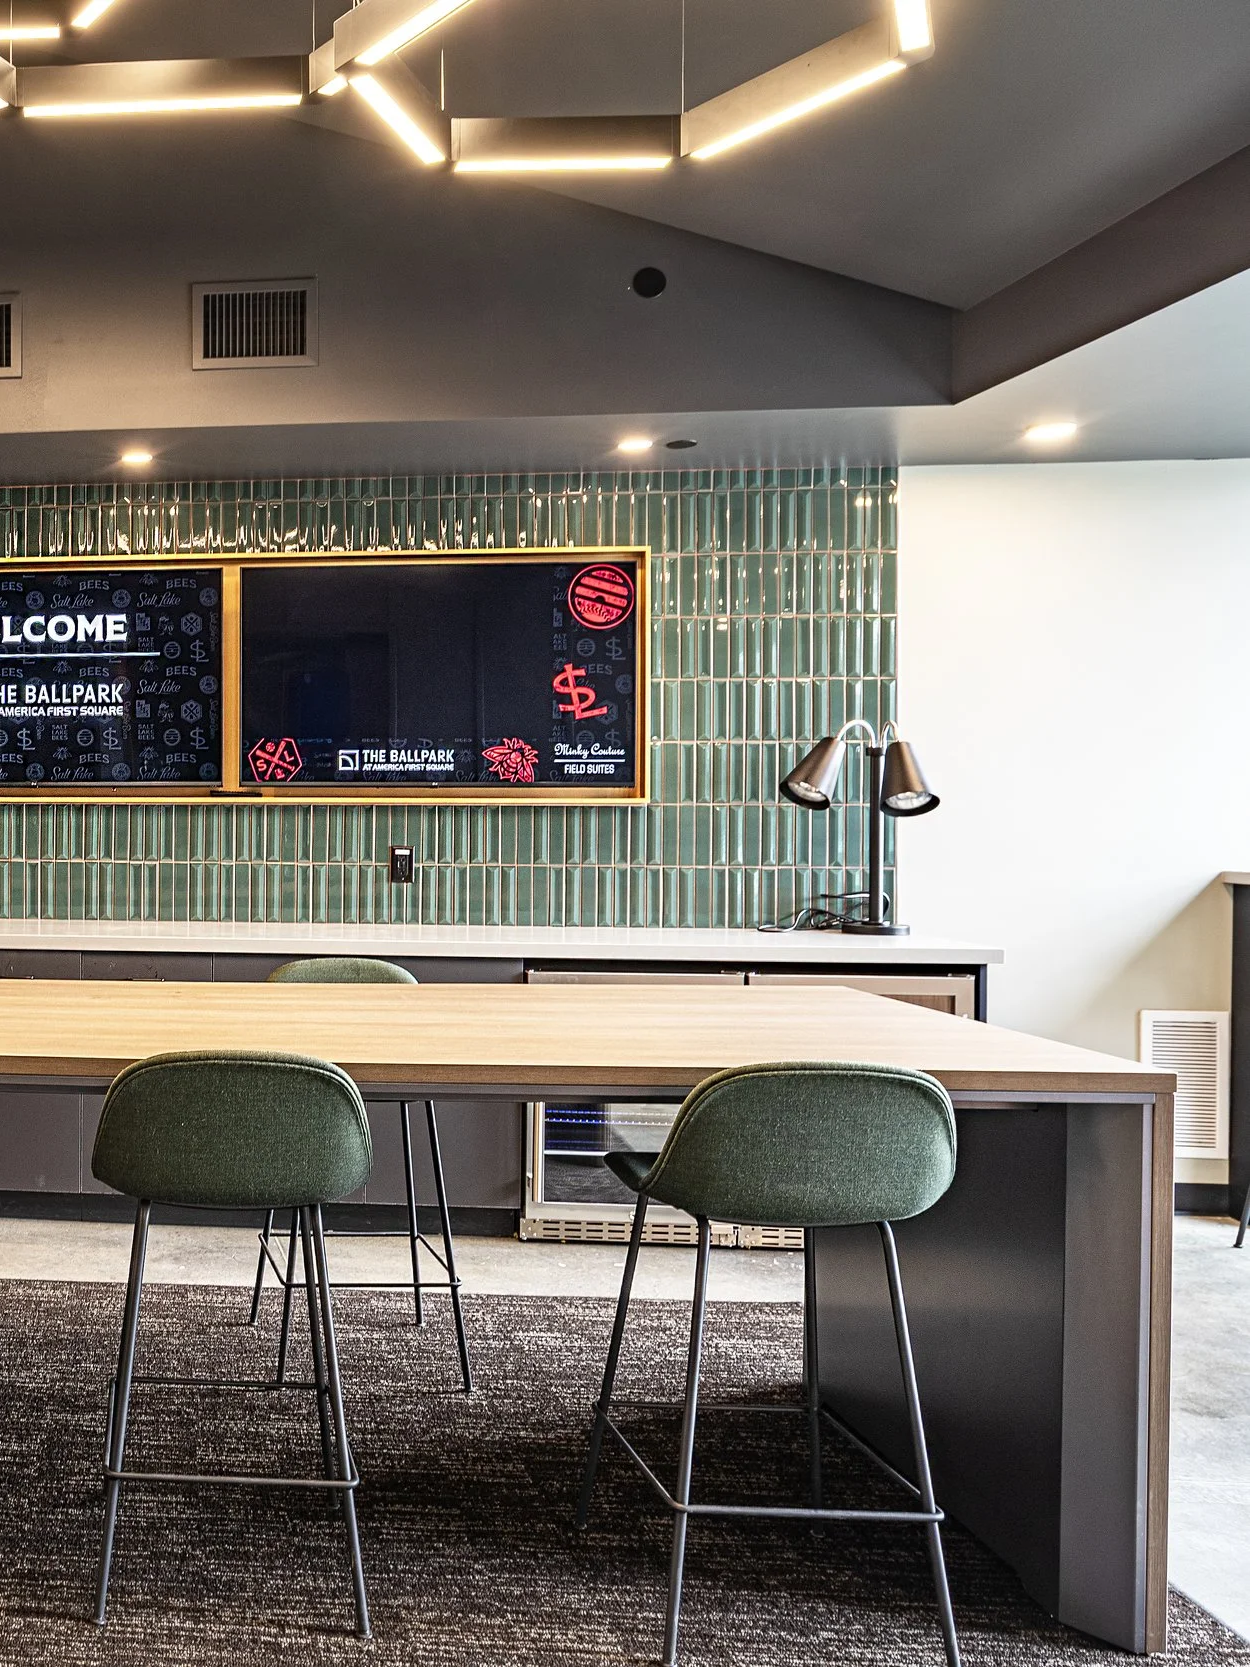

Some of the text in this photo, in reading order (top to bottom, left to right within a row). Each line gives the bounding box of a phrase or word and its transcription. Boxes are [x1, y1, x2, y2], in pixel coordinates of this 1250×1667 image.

[79, 580, 110, 591] BEES
[166, 578, 198, 590] BEES
[51, 593, 71, 609] Salt
[137, 592, 157, 608] Salt
[79, 667, 110, 678] BEES
[166, 666, 198, 678] BEES
[137, 679, 157, 694] Salt
[25, 683, 124, 704] BALLPARK
[47, 706, 79, 717] FIRST
[79, 705, 124, 717] SQUARE
[362, 749, 455, 762] THE BALLPARK
[554, 742, 626, 759] Minky Couture
[79, 753, 110, 764] BEES
[166, 753, 198, 764] BEES
[362, 763, 455, 771] AT AMERICA FIRST SQUARE
[564, 763, 616, 774] FIELD SUITES
[51, 766, 71, 781] Salt
[137, 766, 157, 781] Salt
